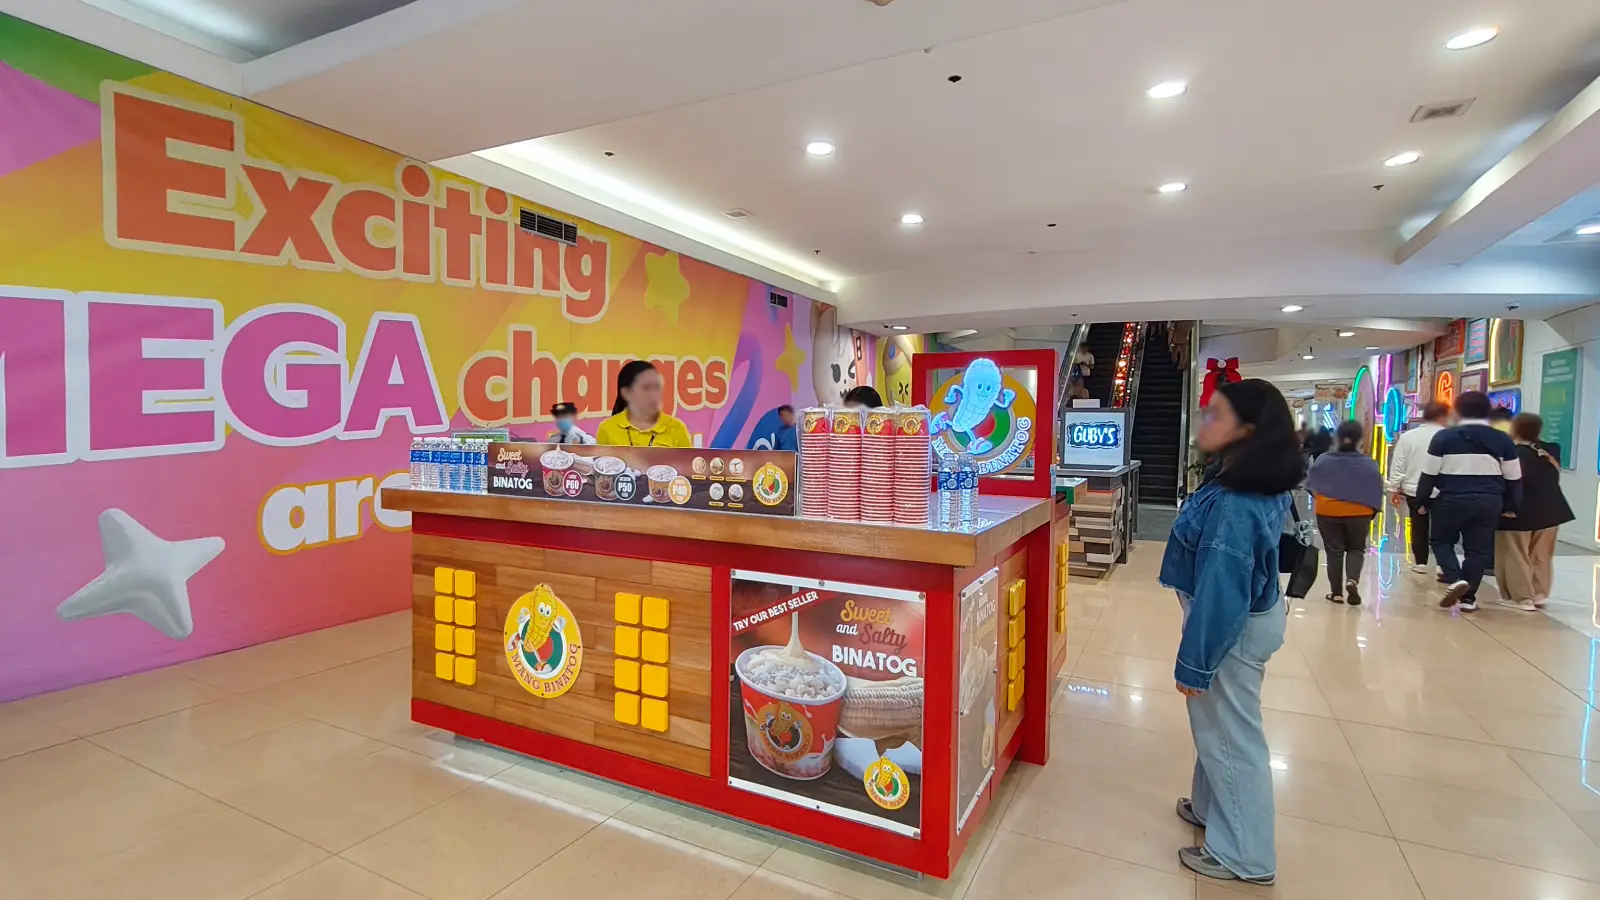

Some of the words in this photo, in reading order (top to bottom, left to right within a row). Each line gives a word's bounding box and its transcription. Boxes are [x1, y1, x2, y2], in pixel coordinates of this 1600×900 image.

[108, 87, 608, 320] Exciting
[978, 416, 1032, 475] BINATOG
[1073, 425, 1116, 444] GUBY'S
[497, 447, 523, 462] Sweet
[493, 476, 533, 490] BINATOG
[733, 619, 749, 632] TRY
[750, 610, 768, 625] OUR
[767, 602, 788, 619] BEST
[786, 590, 819, 610] SELLER
[840, 600, 893, 625] Sweet
[836, 623, 859, 636] and
[859, 624, 908, 654] Salty
[511, 652, 541, 690] MANG
[544, 643, 578, 693] BINATOG
[832, 644, 917, 678] BINATOG
